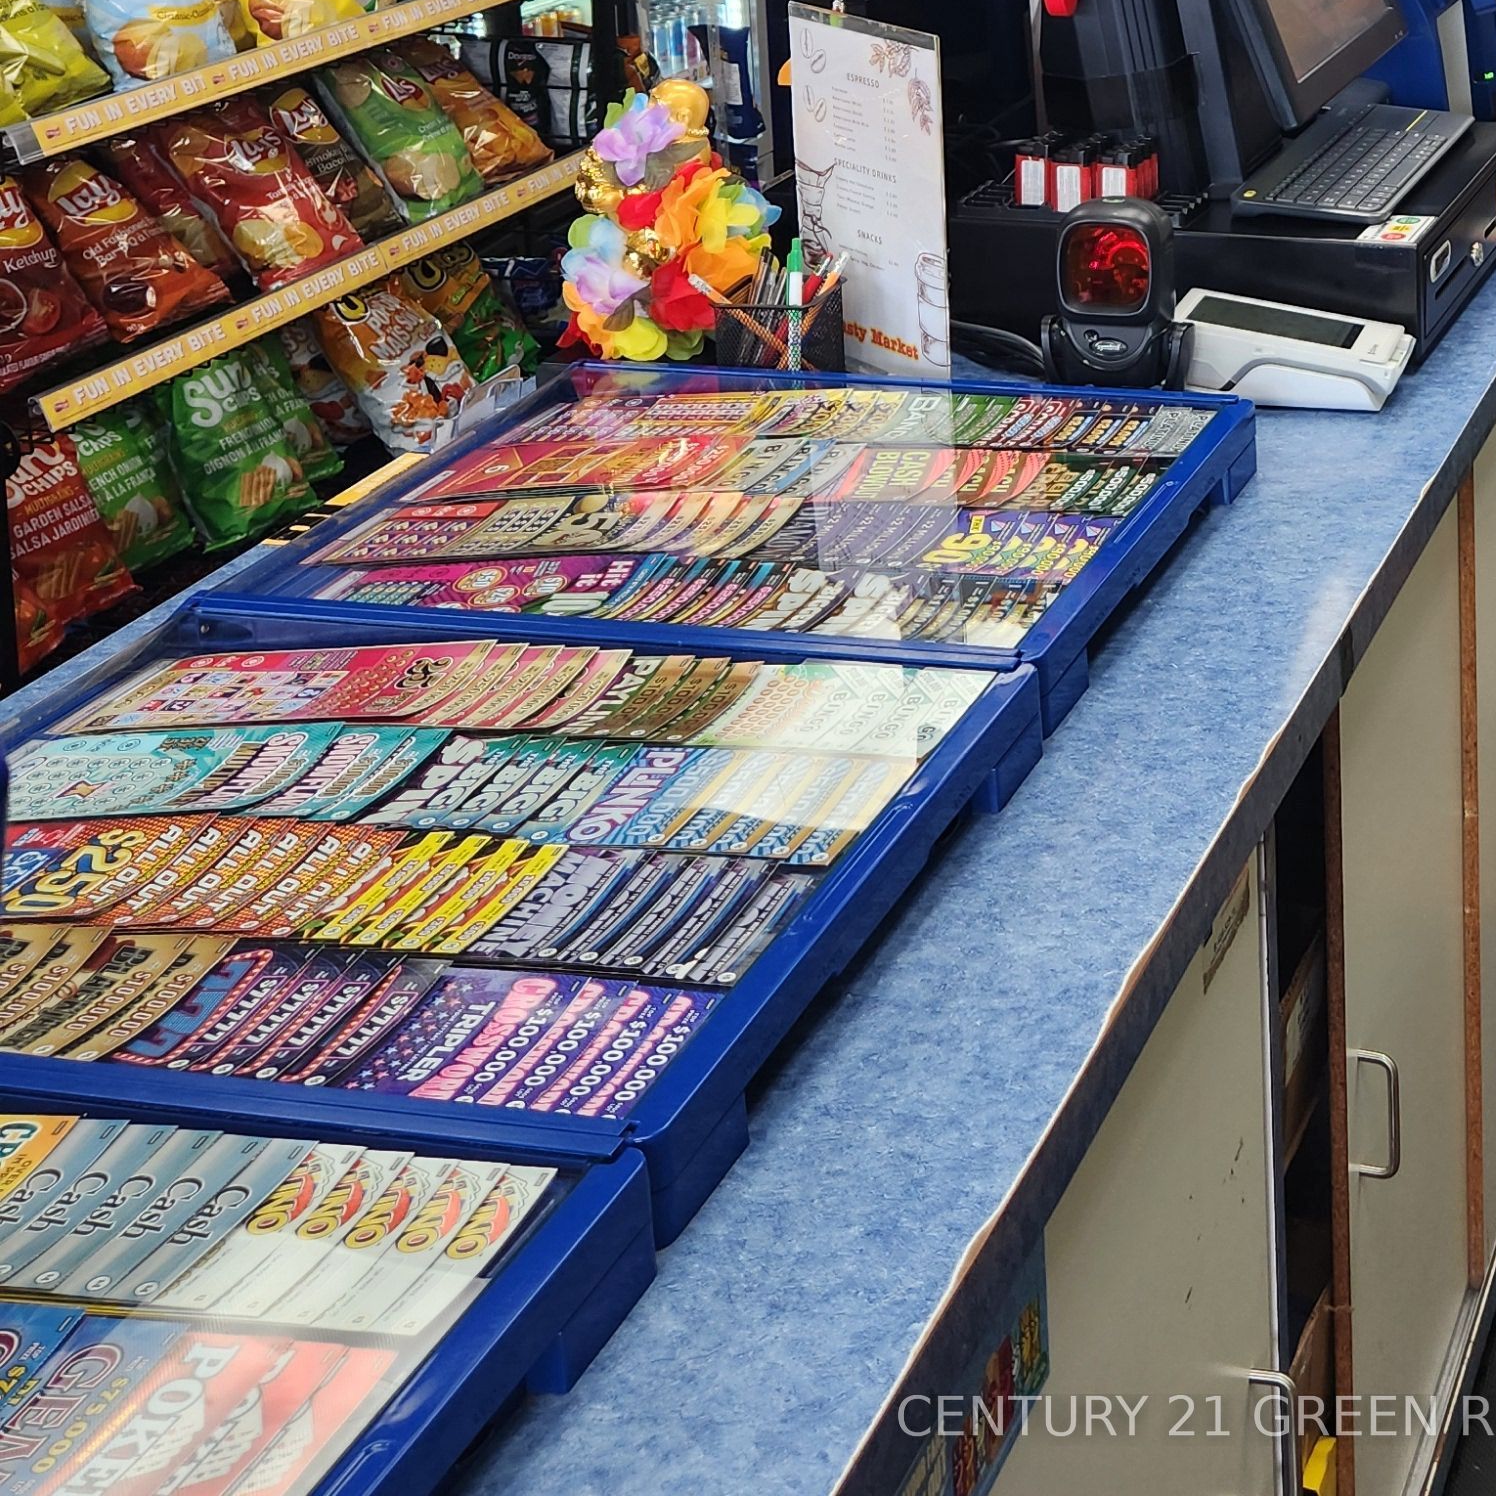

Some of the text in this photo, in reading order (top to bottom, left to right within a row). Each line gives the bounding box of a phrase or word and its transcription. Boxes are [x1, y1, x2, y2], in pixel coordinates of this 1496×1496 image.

[383, 12, 406, 30] FUN
[408, 6, 422, 22] IN
[230, 27, 359, 81] FUN IN EVERY BITE
[846, 72, 880, 89] ESPRESSO
[66, 85, 178, 134] FUN IN EVERY
[527, 177, 548, 193] FUN
[834, 157, 897, 184] SPECIALITY DRINKS
[404, 229, 430, 249] FUN
[445, 204, 482, 227] EVERY
[484, 191, 510, 211] BITE
[857, 229, 882, 245] SNACKS
[2, 246, 58, 275] Ketchup
[251, 254, 380, 324] FUN IN EVERY BITE
[73, 324, 226, 405] FUN IN EVERY BITE
[870, 329, 920, 361] Market
[185, 360, 252, 427] Sun
[221, 385, 262, 415] CHIPS
[78, 431, 123, 456] CHIPS
[890, 451, 933, 486] CASH
[24, 461, 79, 497] CHIPS
[852, 451, 894, 501] BLOWOUT
[13, 495, 92, 539] GARDEN SALSA
[601, 560, 635, 588] Hit
[568, 749, 687, 844] PLINKO
[5, 828, 147, 913] $250
[89, 823, 185, 904] ALL OUT
[128, 825, 222, 911] ALL OUT
[171, 871, 223, 912] OUT
[397, 1000, 497, 1082] TRIPLER
[524, 1009, 603, 1087] $100,000
[570, 1020, 648, 1096] $100,000
[613, 1025, 691, 1102] $100,000
[71, 1174, 155, 1238] Cash
[119, 1177, 205, 1241] Cash
[167, 1184, 251, 1246] Cash
